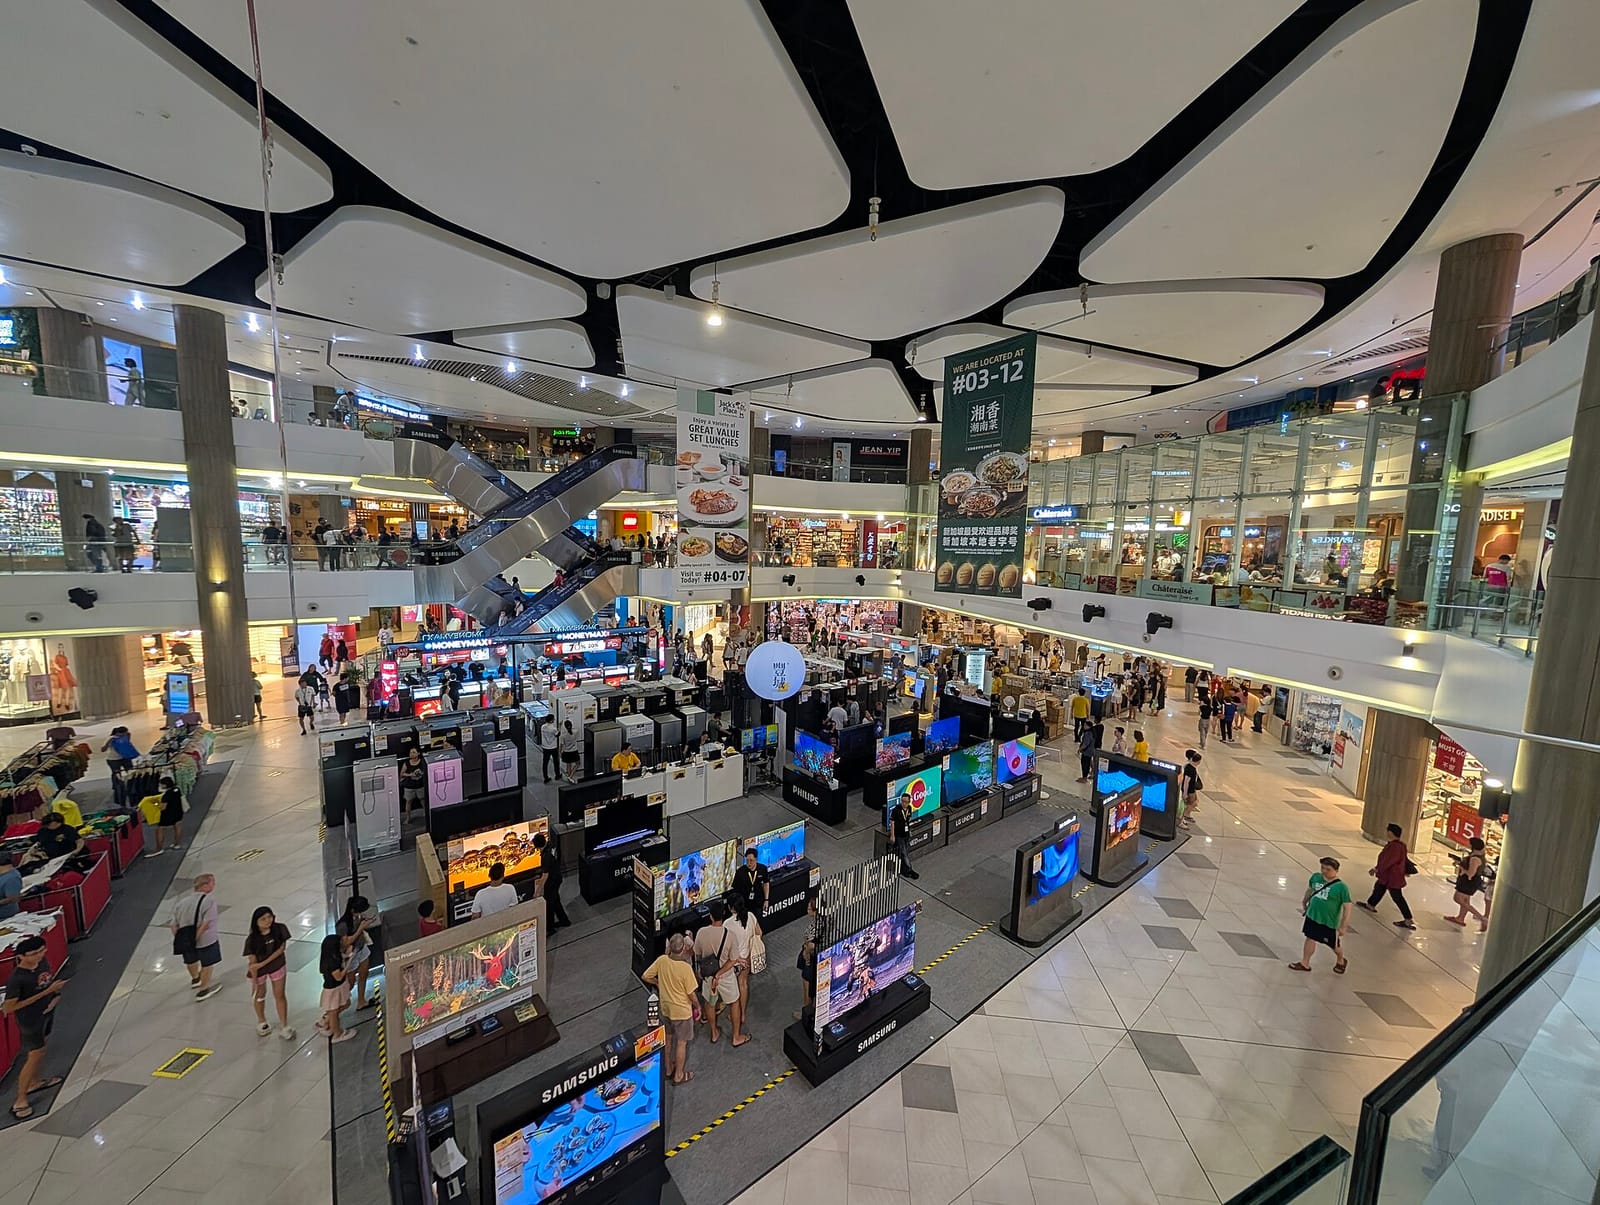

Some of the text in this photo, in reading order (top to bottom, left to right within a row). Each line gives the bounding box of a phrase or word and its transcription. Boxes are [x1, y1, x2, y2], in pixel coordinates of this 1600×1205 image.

[952, 348, 1025, 374] WE ARE LOCATED AT
[952, 360, 1023, 395] #03-12
[719, 400, 735, 409] Jack's
[970, 400, 1001, 422] 湘香
[693, 417, 706, 425] Enjoy
[712, 420, 729, 428] variety
[688, 423, 740, 439] GREAT VALUE
[689, 433, 704, 442] SET
[706, 436, 739, 447] LUNCHES
[680, 577, 700, 585] Today!
[703, 570, 746, 583] #04-07
[431, 638, 488, 650] MONEYMAX
[1438, 742, 1456, 753] MUST
[792, 784, 819, 806] PHILIPS
[614, 861, 648, 877] BRAA
[762, 891, 806, 918] SAMSUNG
[857, 1020, 897, 1053] SAMSUNG
[542, 1055, 618, 1104] SAMSUNG
